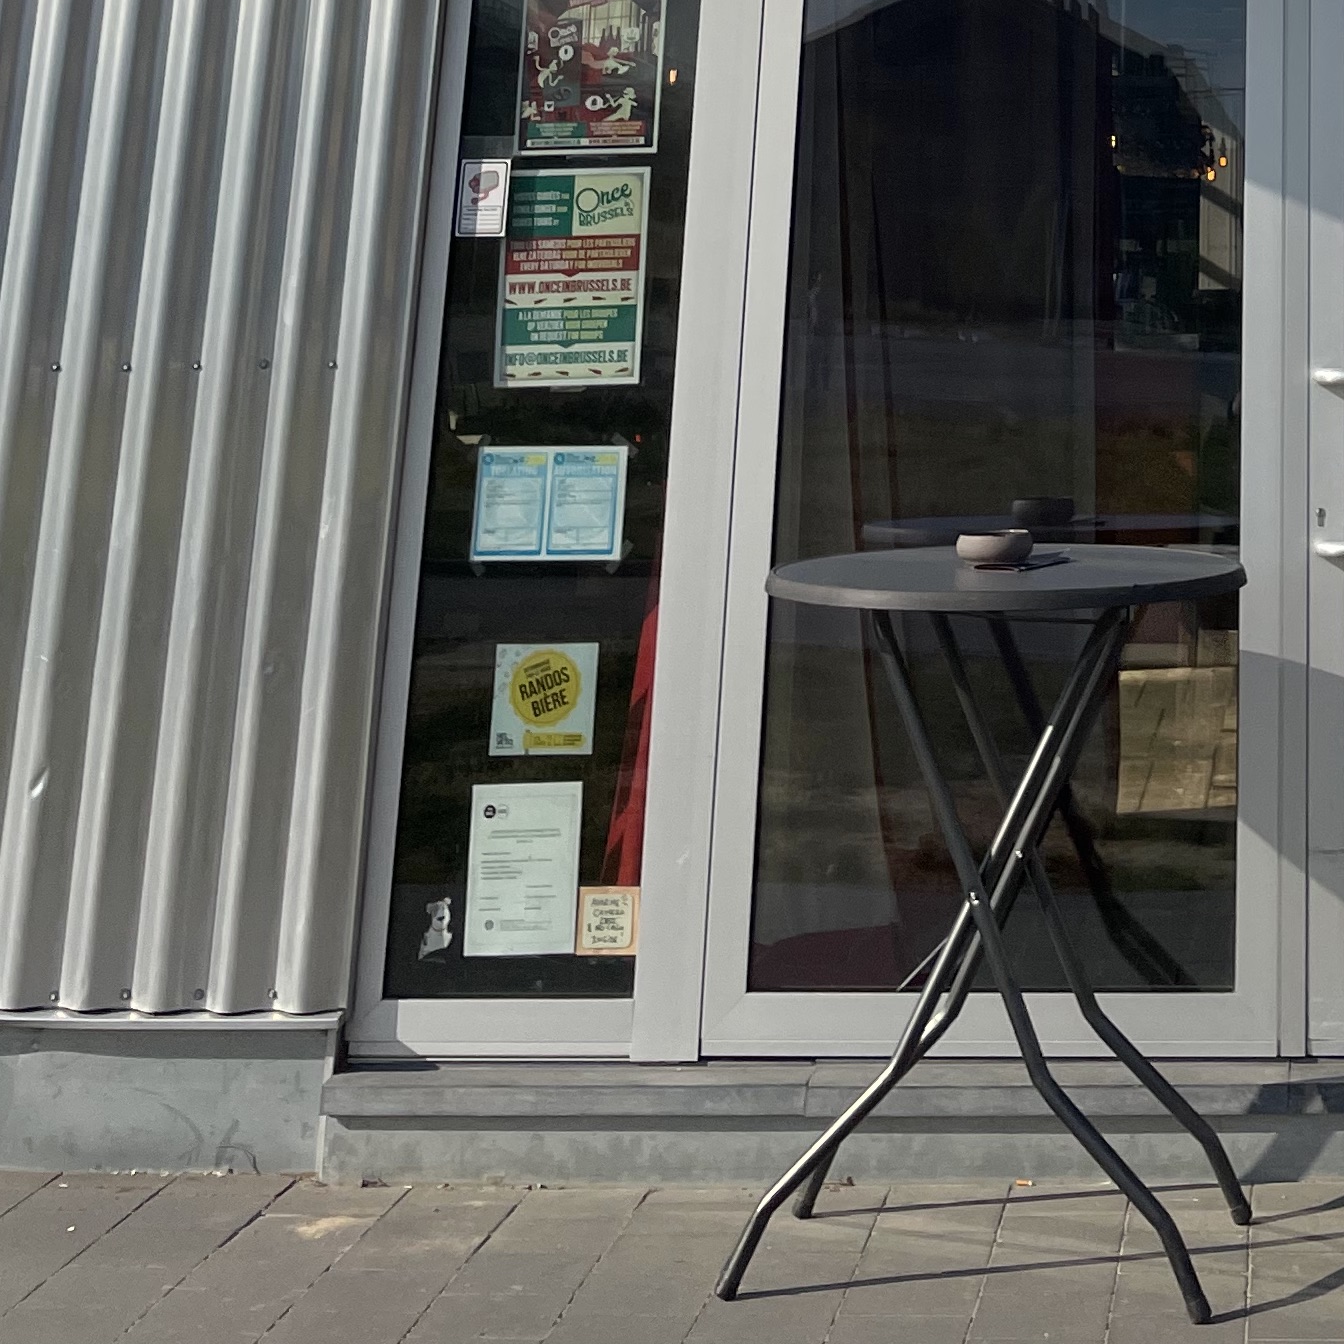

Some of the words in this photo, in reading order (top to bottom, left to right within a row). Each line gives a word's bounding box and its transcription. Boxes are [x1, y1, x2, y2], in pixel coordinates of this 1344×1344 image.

[576, 183, 633, 213] Once
[578, 206, 634, 227] BRUSSELS
[508, 278, 632, 295] WWW.ONCEINBRUSSELS.BE
[518, 666, 570, 701] RANDOS
